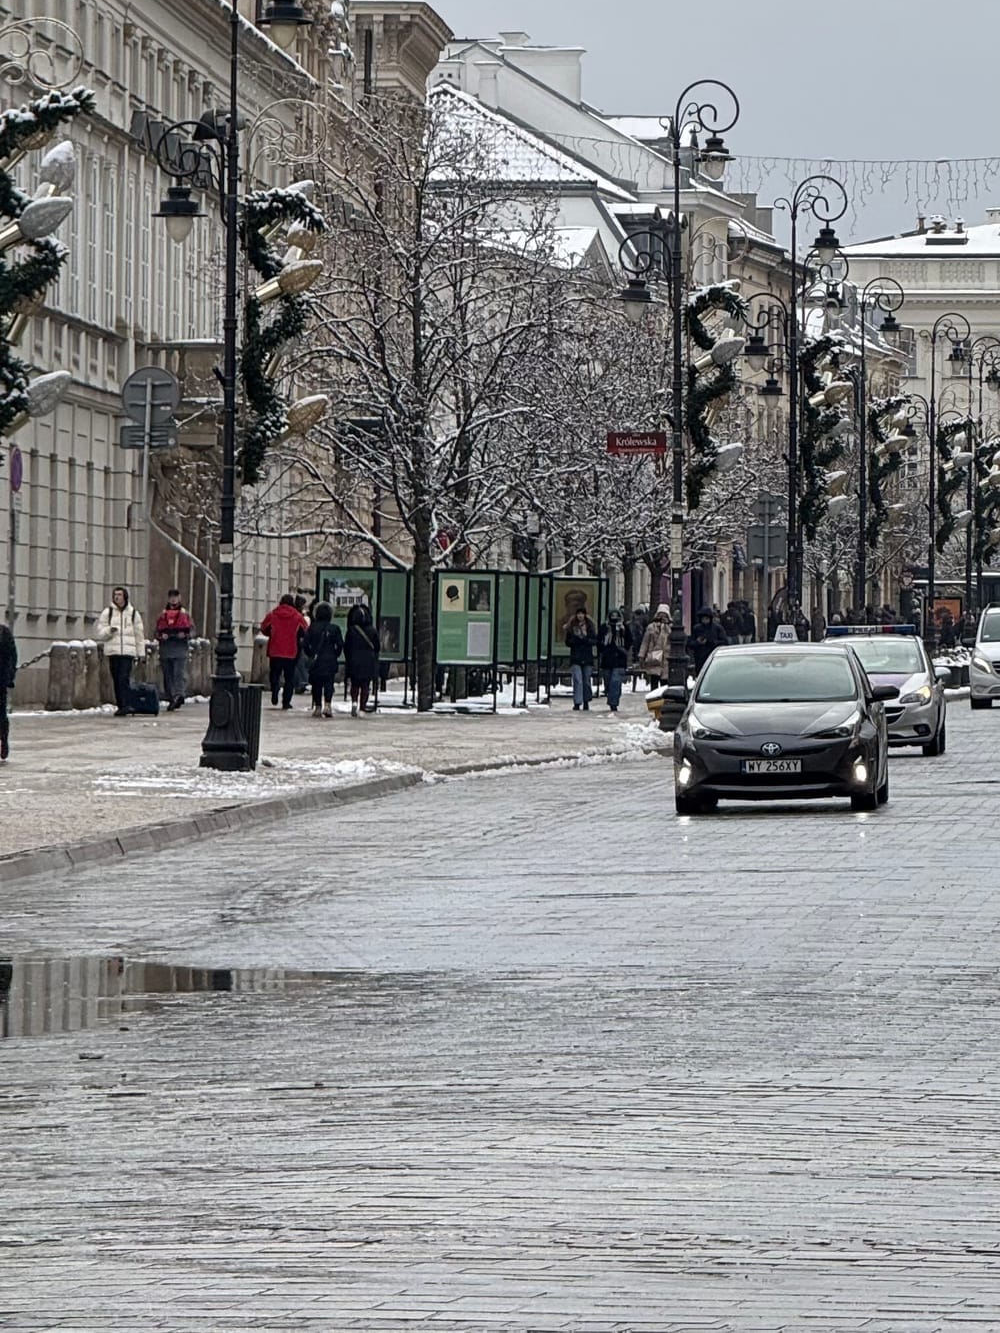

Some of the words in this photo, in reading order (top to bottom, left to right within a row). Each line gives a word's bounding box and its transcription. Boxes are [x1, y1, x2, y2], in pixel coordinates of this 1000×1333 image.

[615, 436, 657, 446] Królewska
[748, 761, 761, 771] WY
[766, 761, 799, 771] 256XY
